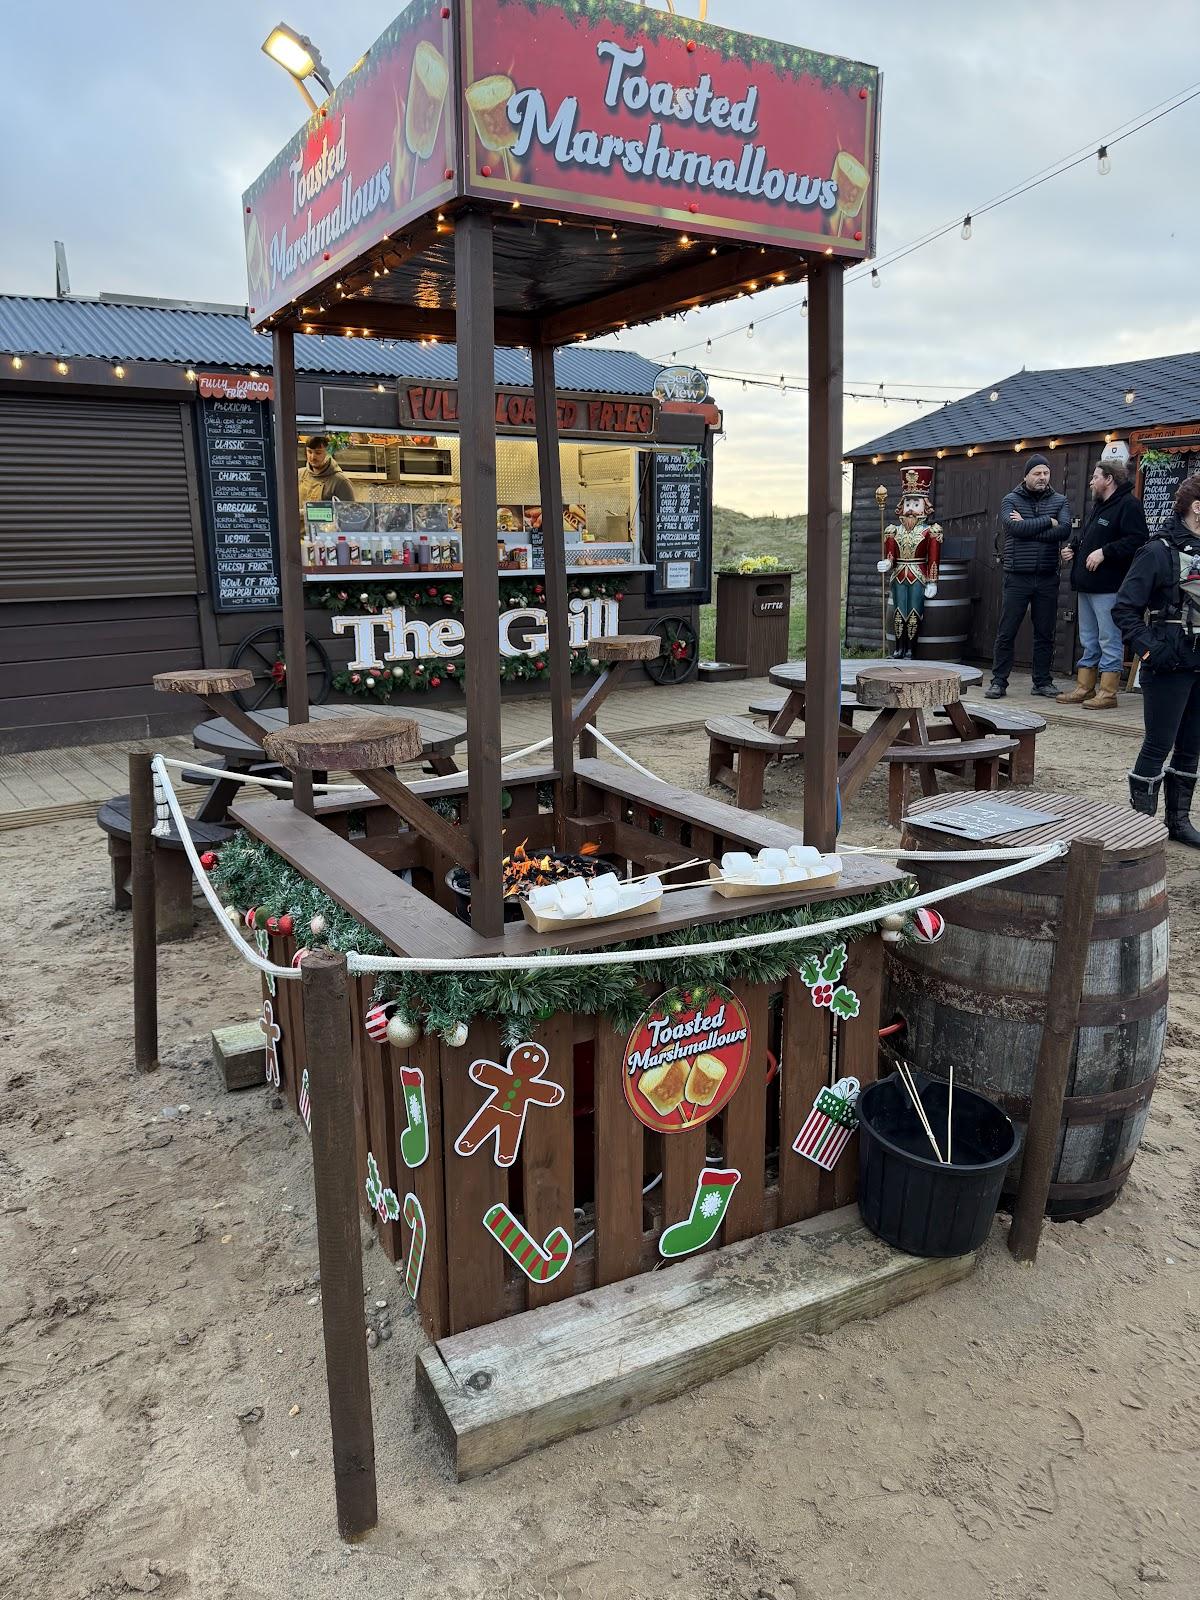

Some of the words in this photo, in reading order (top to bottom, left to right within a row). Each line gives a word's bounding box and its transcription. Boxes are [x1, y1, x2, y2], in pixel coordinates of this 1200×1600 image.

[596, 40, 758, 133] Toasted
[508, 87, 837, 210] Marshmallows
[289, 114, 347, 216] Toasted
[270, 162, 390, 290] Marshmallows
[668, 373, 691, 383] Seal
[237, 381, 269, 392] LOADED
[663, 383, 699, 398] View
[214, 402, 252, 411] MEXICAN
[496, 393, 578, 428] LOAED
[588, 401, 651, 432] FRIES
[215, 440, 245, 450] CLASSIC
[219, 472, 251, 481] CHINESE
[1145, 477, 1179, 485] CAPPUCCINO
[217, 503, 257, 512] BARBEQUE
[218, 562, 244, 573] CHEESY
[248, 562, 268, 570] FRIES
[221, 578, 242, 588] BOWL
[245, 578, 256, 586] OF
[259, 577, 278, 586] FRIES
[761, 602, 783, 610] LITTER
[332, 606, 466, 671] The
[498, 596, 620, 658] Gill
[648, 1004, 725, 1048] Toasted
[628, 1027, 747, 1074] Marshmallows
